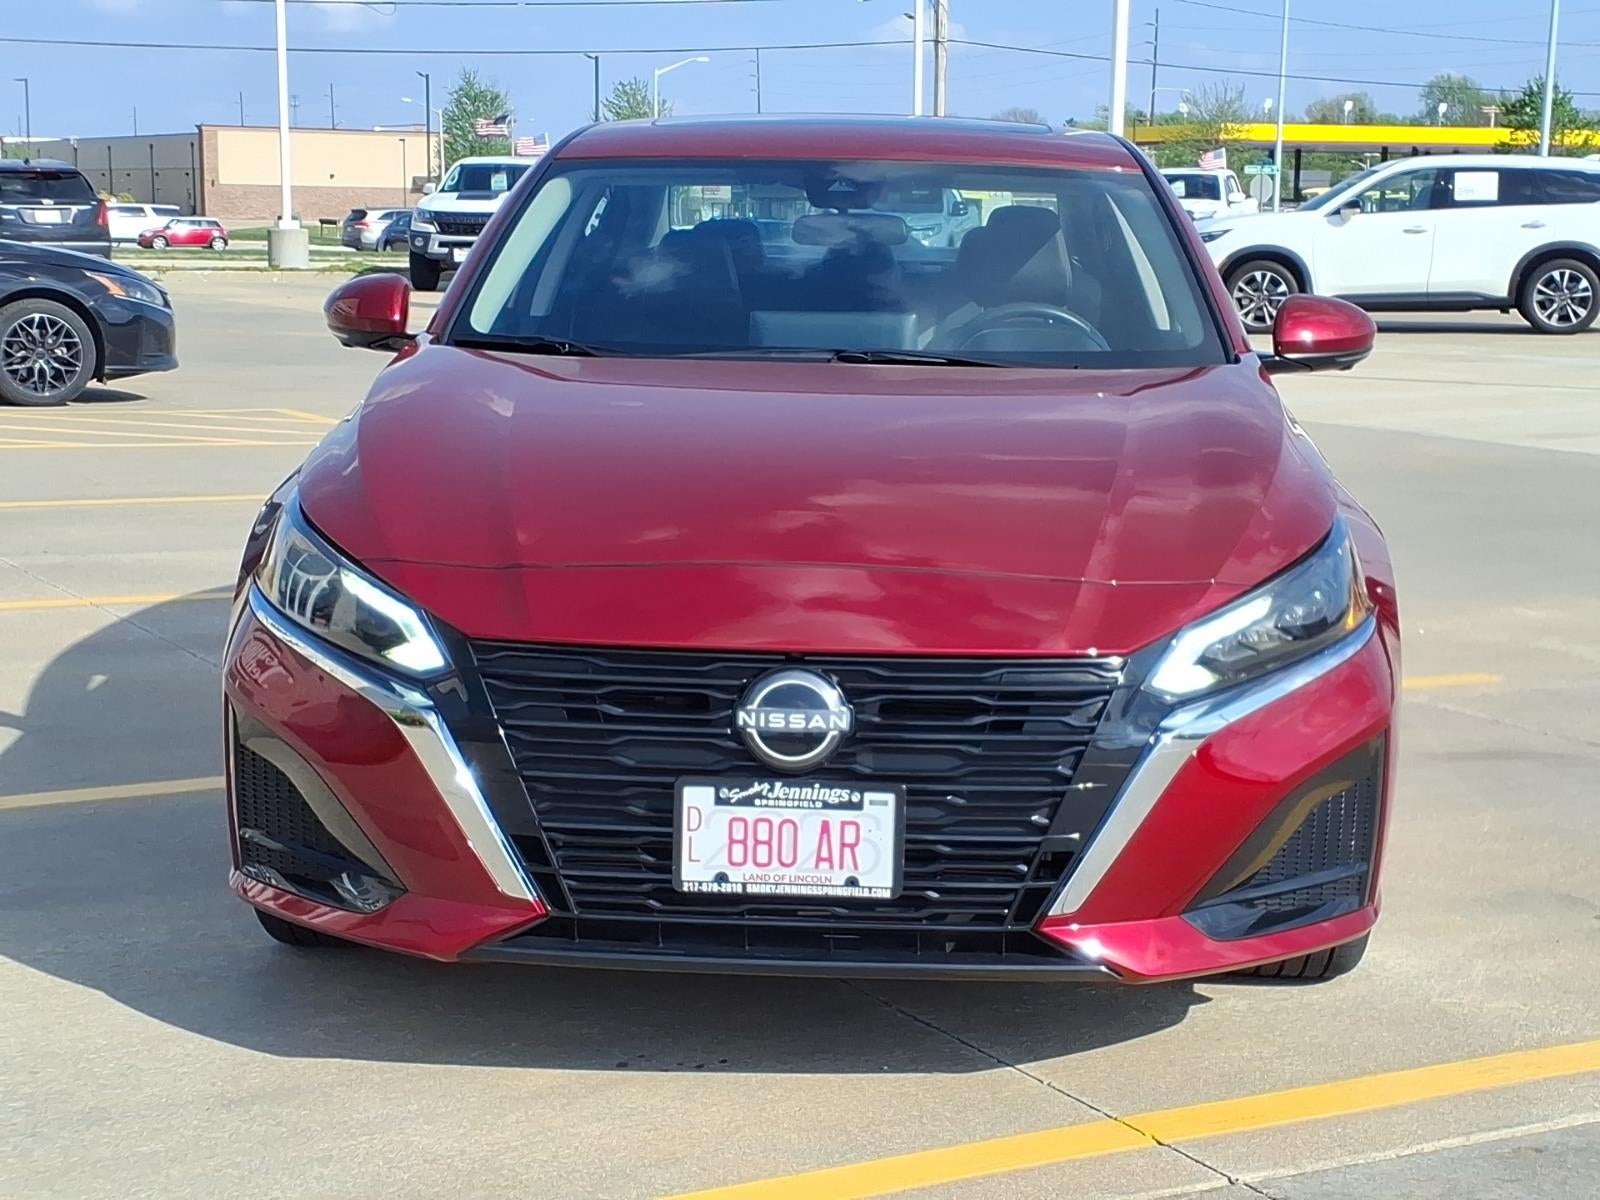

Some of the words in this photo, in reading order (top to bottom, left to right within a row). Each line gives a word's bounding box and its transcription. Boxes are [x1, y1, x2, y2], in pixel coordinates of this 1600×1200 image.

[738, 710, 847, 729] NISSAN
[768, 781, 850, 804] Jennings
[754, 798, 823, 809] SPRINGFIELD
[727, 816, 799, 868] 880
[814, 819, 861, 871] AR
[743, 873, 771, 882] LAND
[773, 874, 787, 883] OF
[788, 875, 833, 884] LINCOLN
